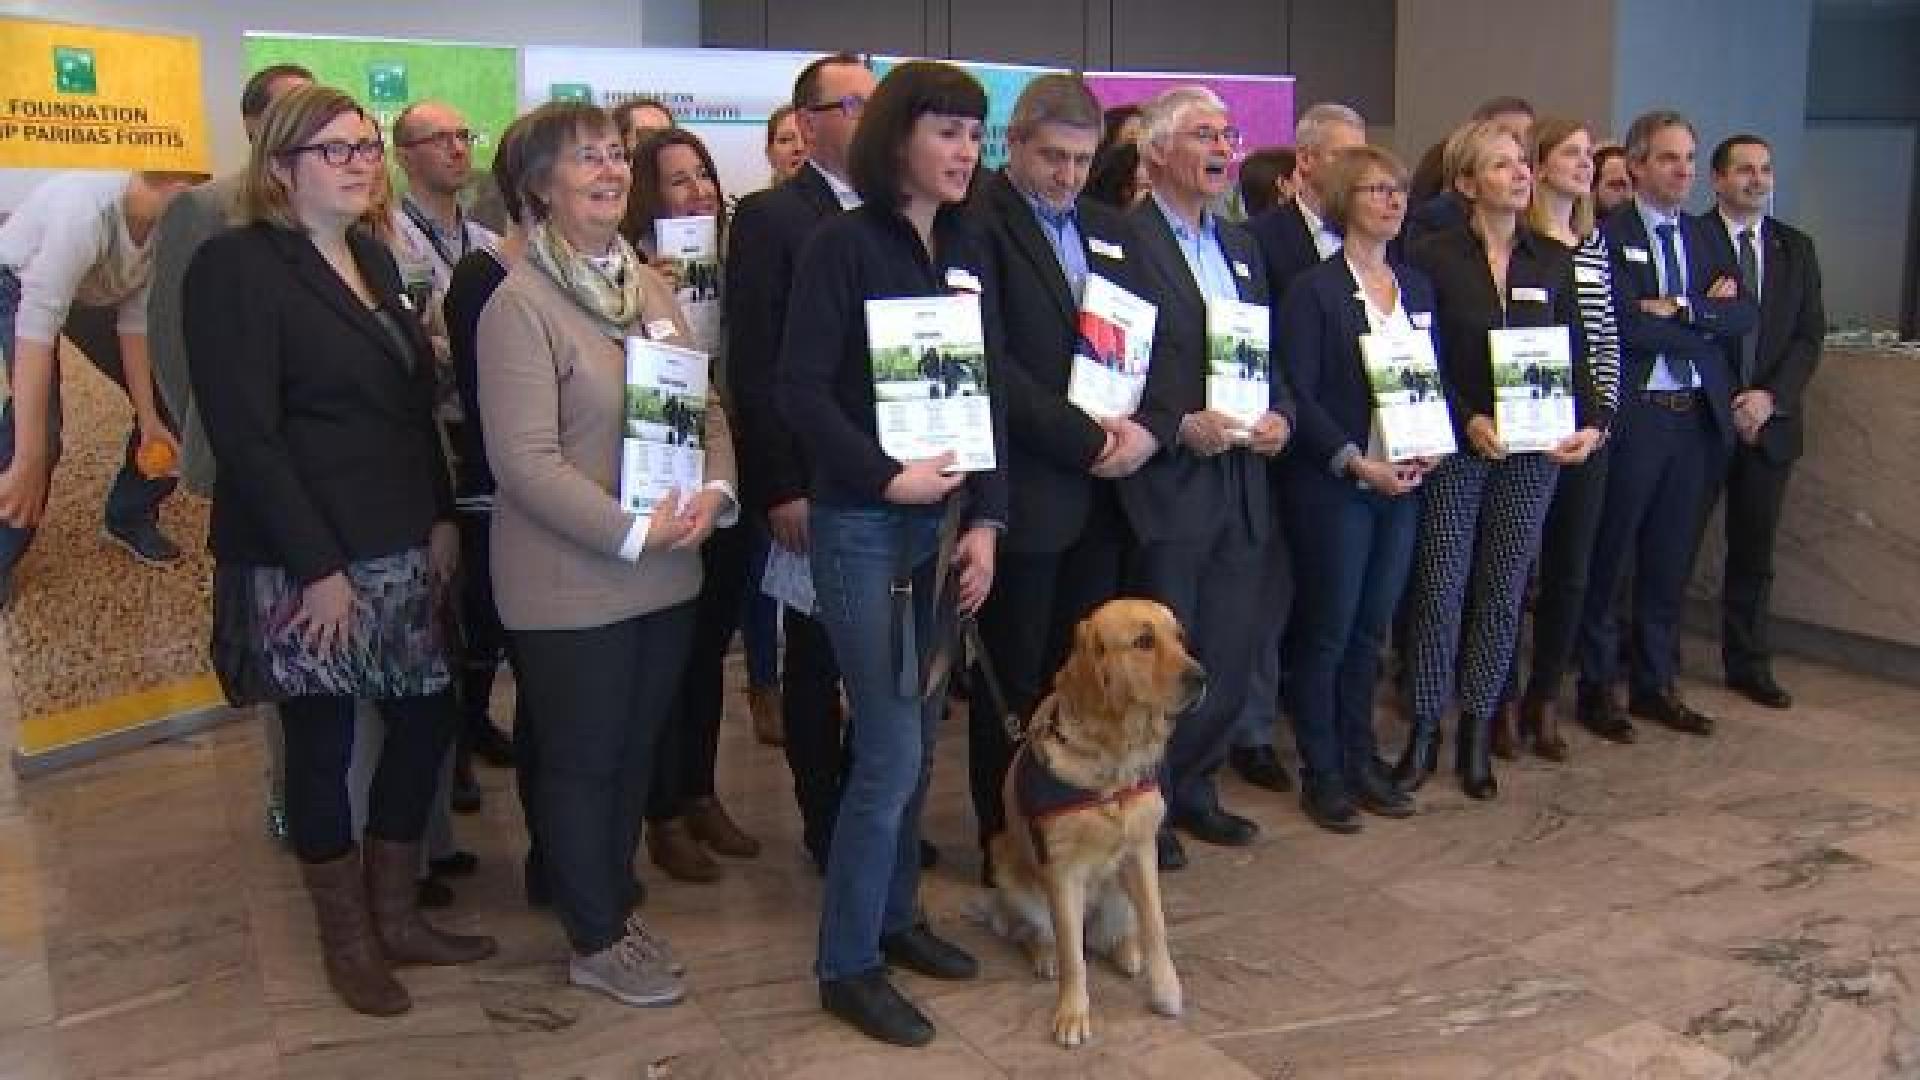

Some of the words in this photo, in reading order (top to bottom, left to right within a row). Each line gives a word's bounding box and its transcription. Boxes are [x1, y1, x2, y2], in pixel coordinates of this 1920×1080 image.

[8, 98, 148, 124] FOUNDATION
[23, 125, 112, 145] PARIBAS
[116, 130, 184, 148] FORTIS
